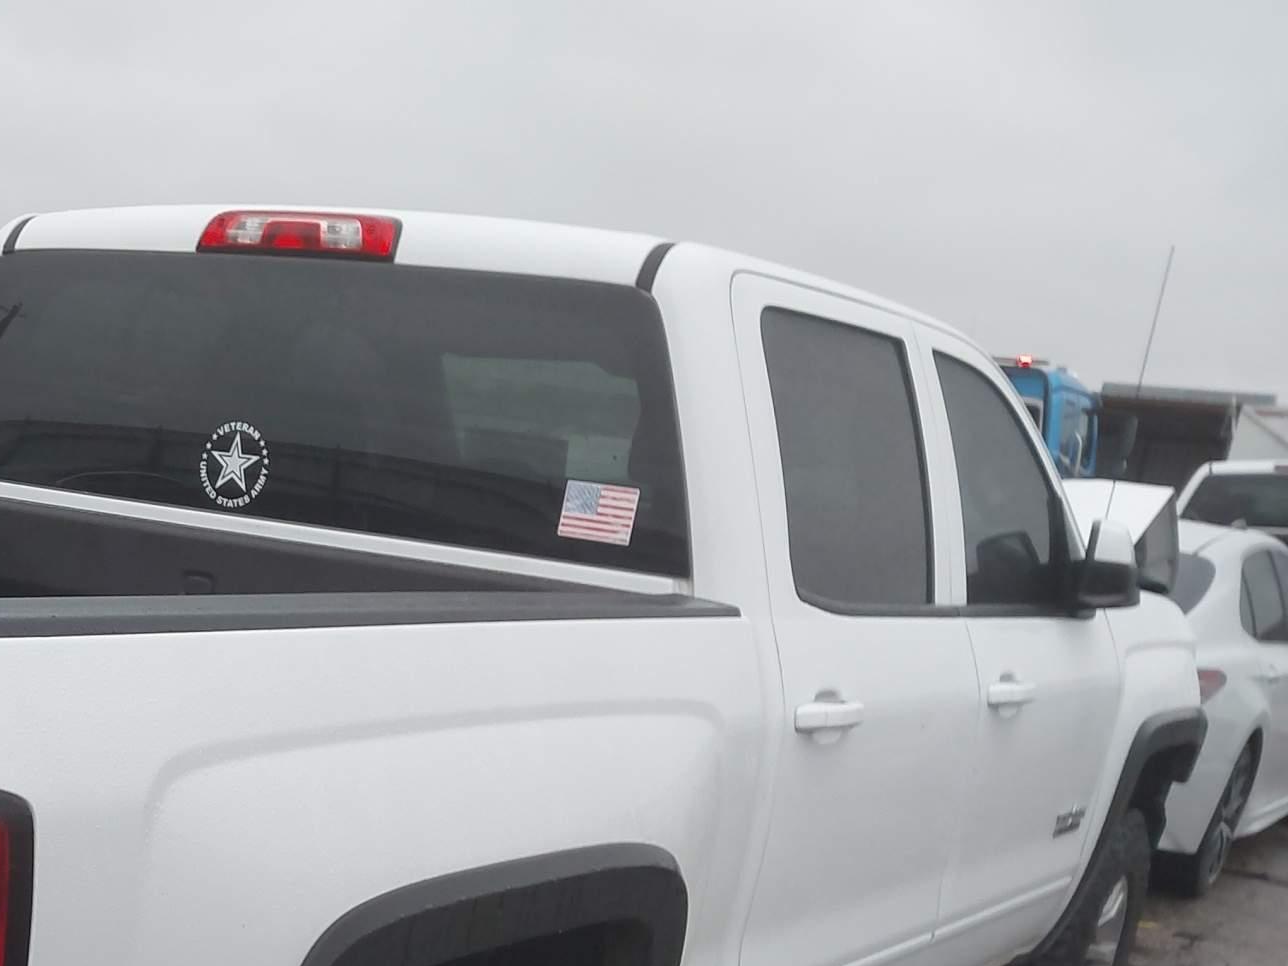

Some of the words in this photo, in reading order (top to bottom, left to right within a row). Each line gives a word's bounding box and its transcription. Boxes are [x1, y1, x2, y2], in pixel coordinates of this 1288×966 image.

[217, 421, 261, 440] VETERAN
[199, 460, 217, 499] UNITED
[216, 494, 251, 508] STATES
[250, 466, 269, 499] ARMY
